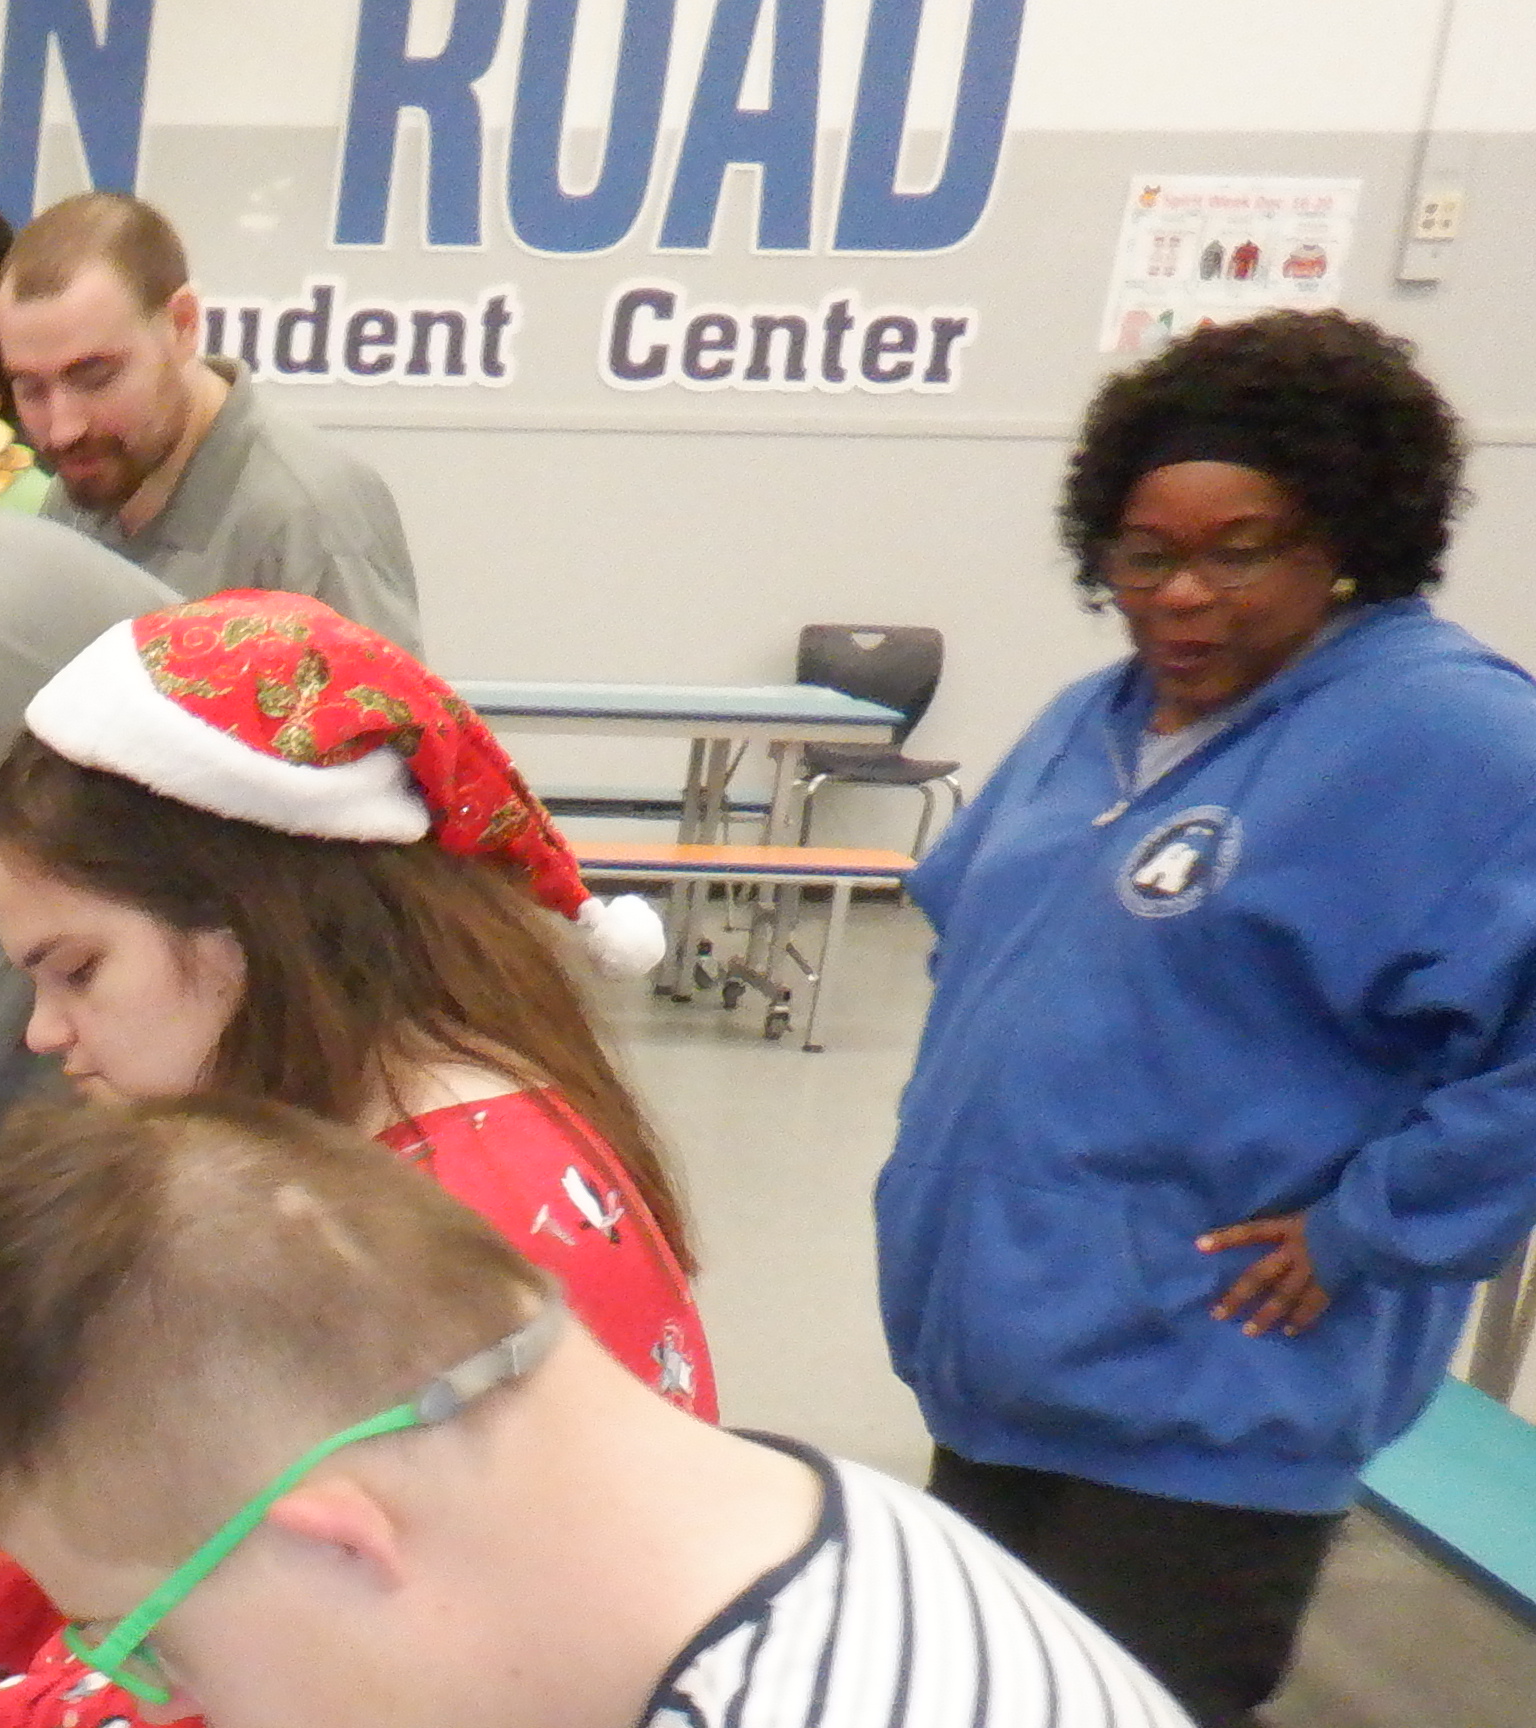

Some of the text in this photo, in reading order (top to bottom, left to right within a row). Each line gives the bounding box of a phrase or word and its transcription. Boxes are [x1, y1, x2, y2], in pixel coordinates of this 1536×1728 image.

[333, 0, 1026, 253] ROAD
[205, 284, 514, 377] udent
[608, 287, 969, 385] Center
